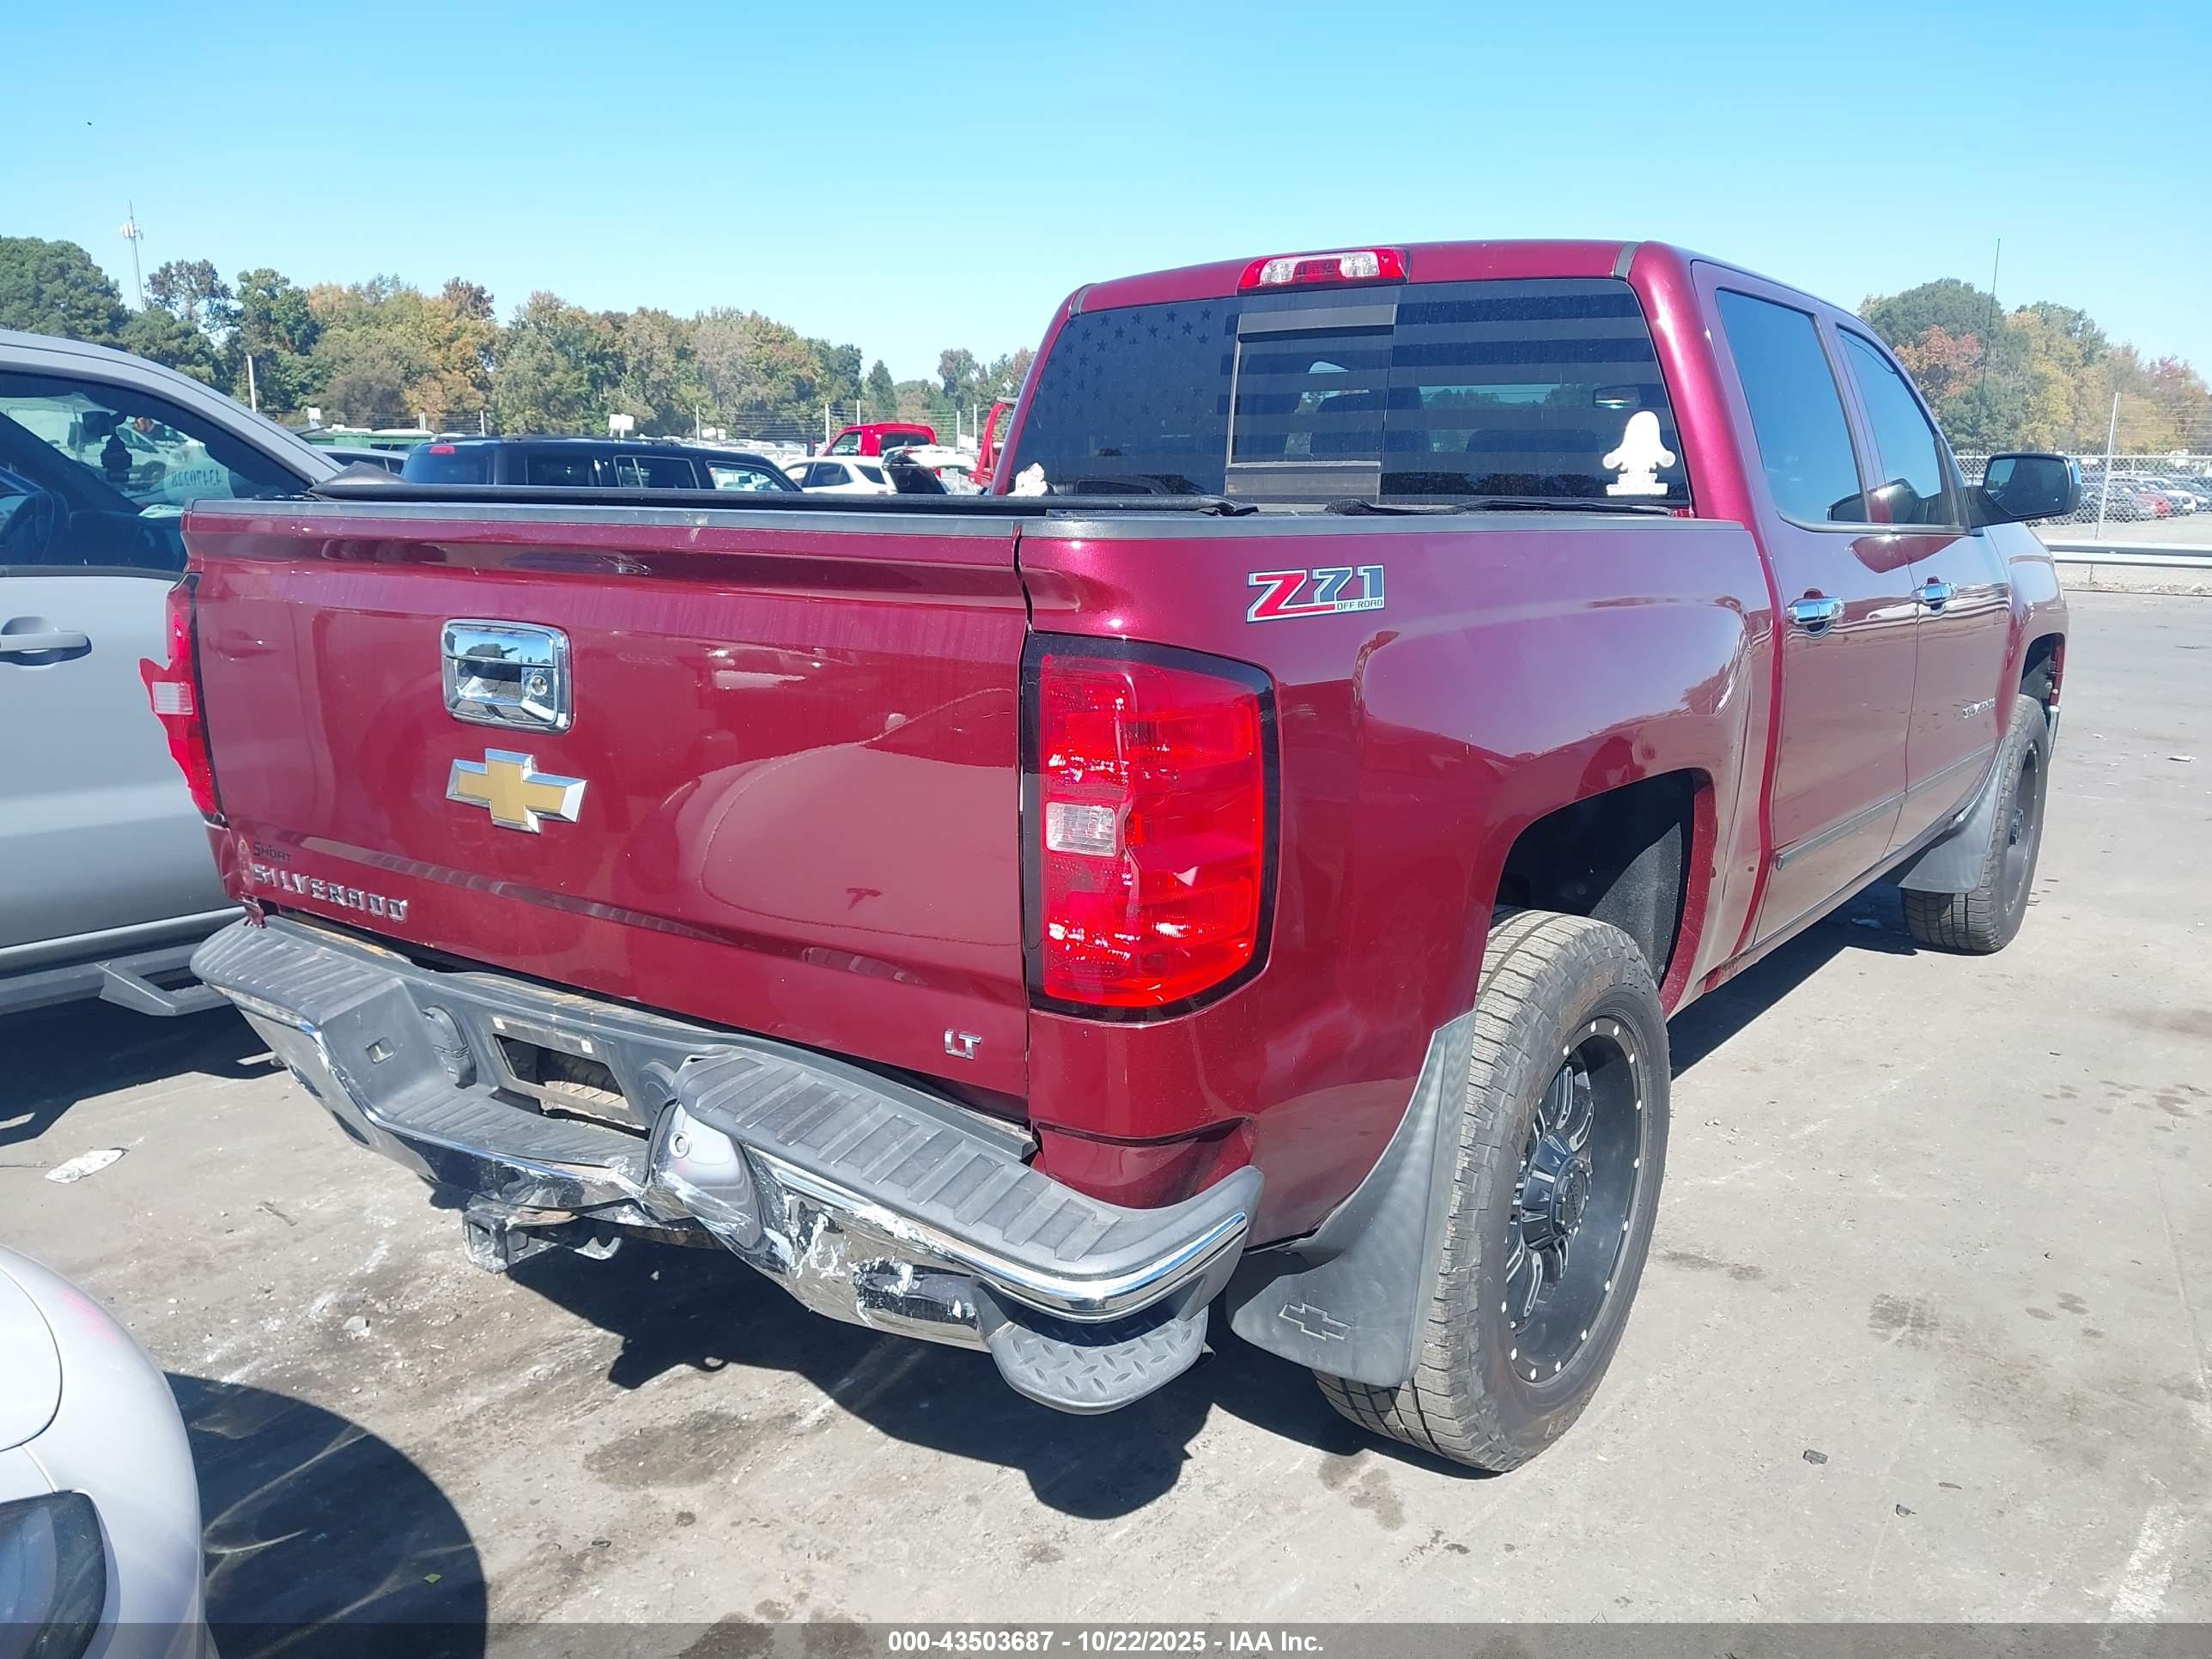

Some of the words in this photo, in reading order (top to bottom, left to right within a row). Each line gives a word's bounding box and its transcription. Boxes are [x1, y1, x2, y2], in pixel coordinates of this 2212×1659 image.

[1246, 563, 1385, 624] Z71
[1336, 601, 1355, 611] OFF
[1358, 599, 1383, 609] ROAD
[252, 863, 408, 921] SILVERADO
[944, 1030, 982, 1060] LT
